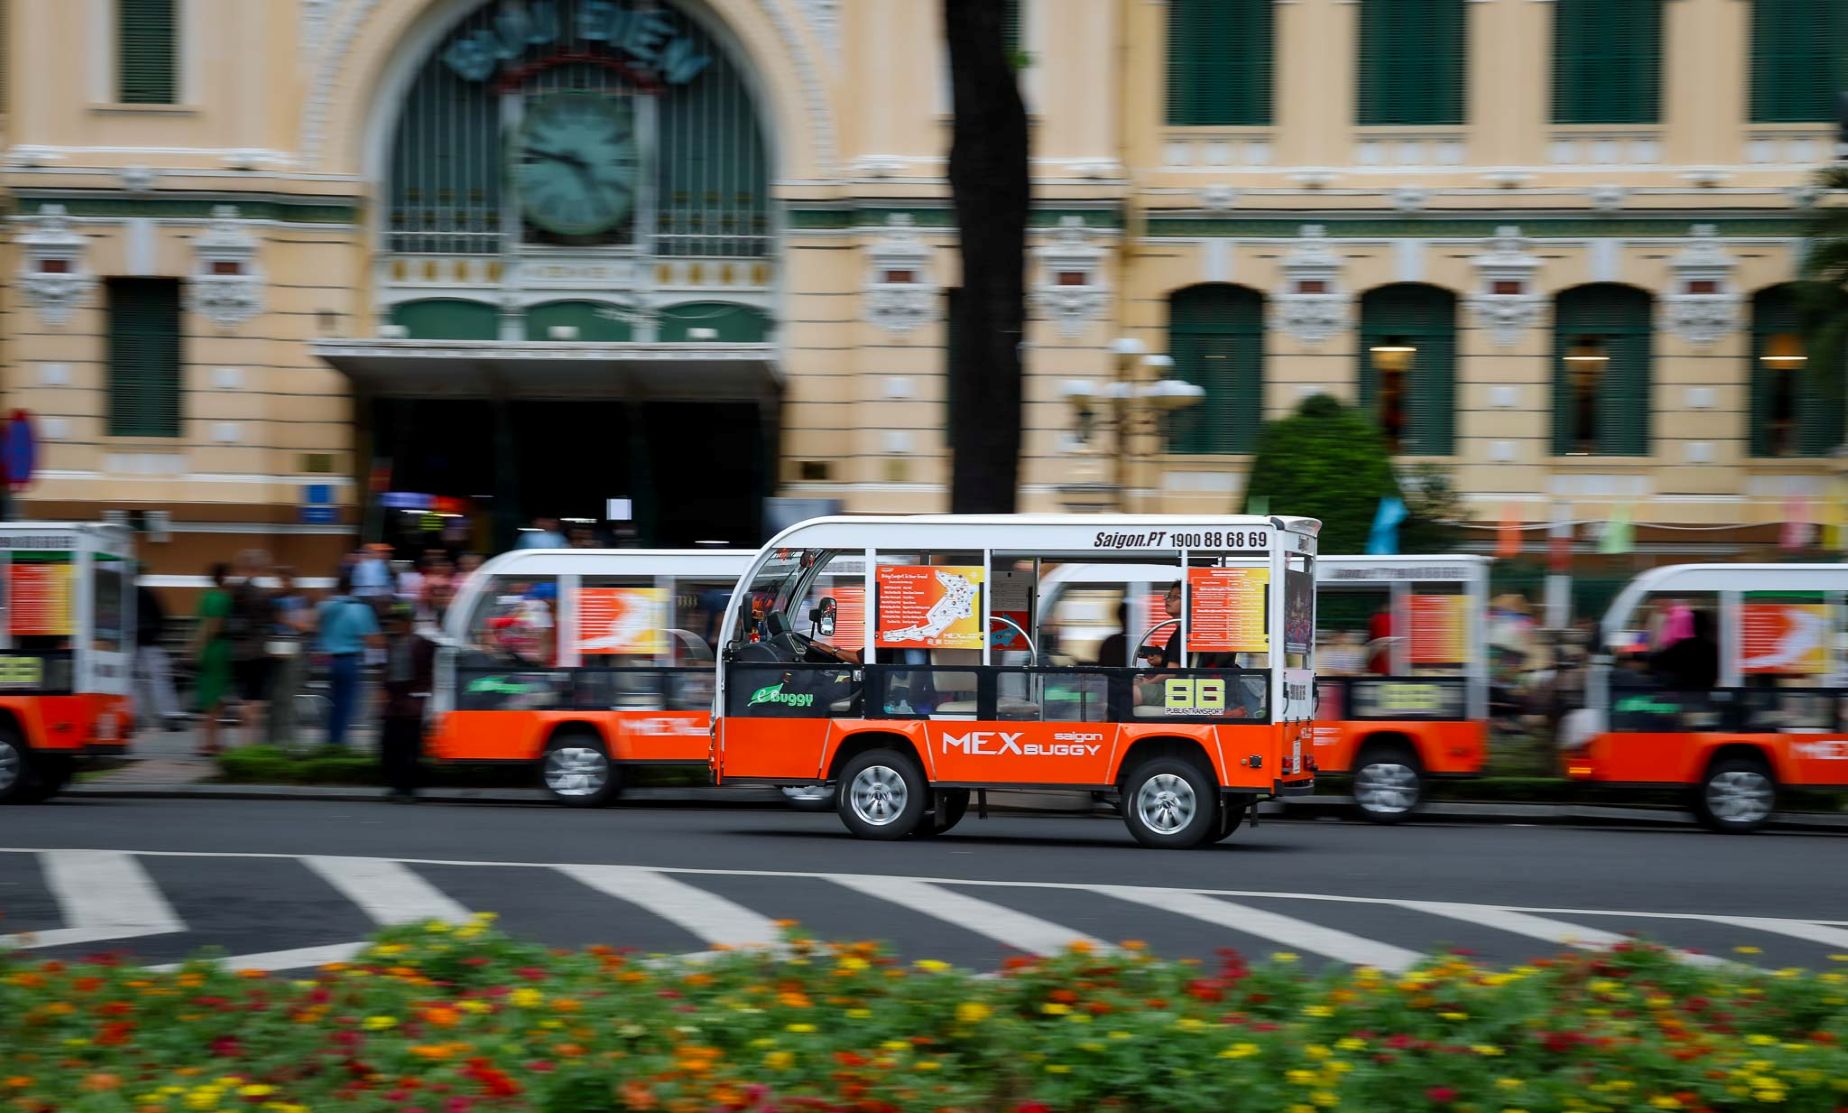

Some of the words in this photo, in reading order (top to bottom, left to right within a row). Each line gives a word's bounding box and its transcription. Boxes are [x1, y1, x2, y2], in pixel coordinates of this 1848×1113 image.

[1093, 532, 1166, 549] Saigon.PT
[1170, 533, 1200, 547] 1900
[1204, 532, 1222, 547] 88
[1226, 532, 1244, 547] 68
[1249, 532, 1267, 547] 69
[1054, 731, 1103, 742] saigon
